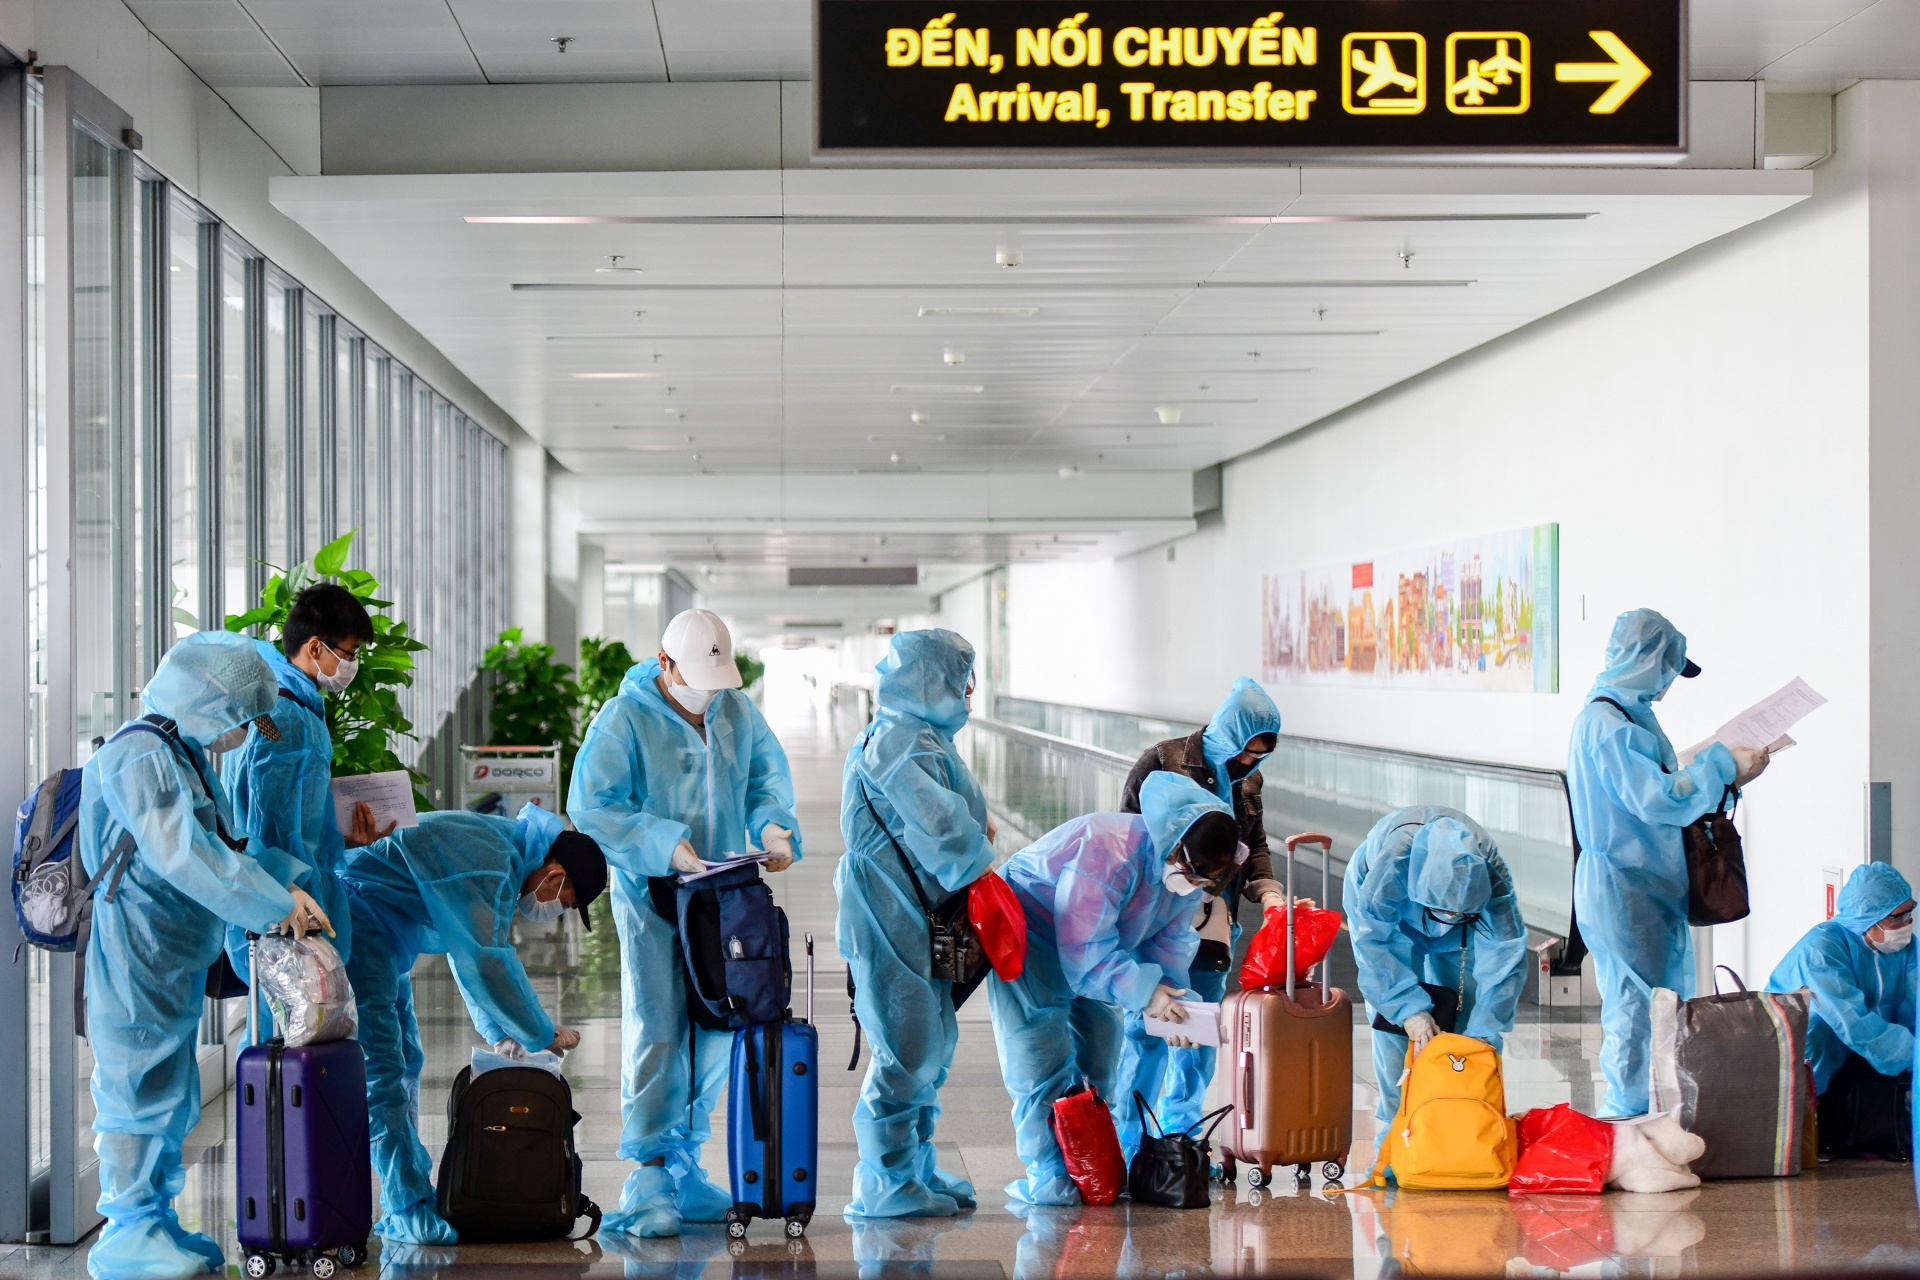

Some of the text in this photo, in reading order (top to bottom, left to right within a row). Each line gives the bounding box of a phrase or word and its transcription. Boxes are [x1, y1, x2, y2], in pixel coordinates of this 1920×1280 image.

[885, 12, 1004, 74] ĐẾN,
[1016, 12, 1102, 67] NỐI
[944, 81, 1317, 128] Arrival, Transfer
[491, 767, 544, 778] DORCO
